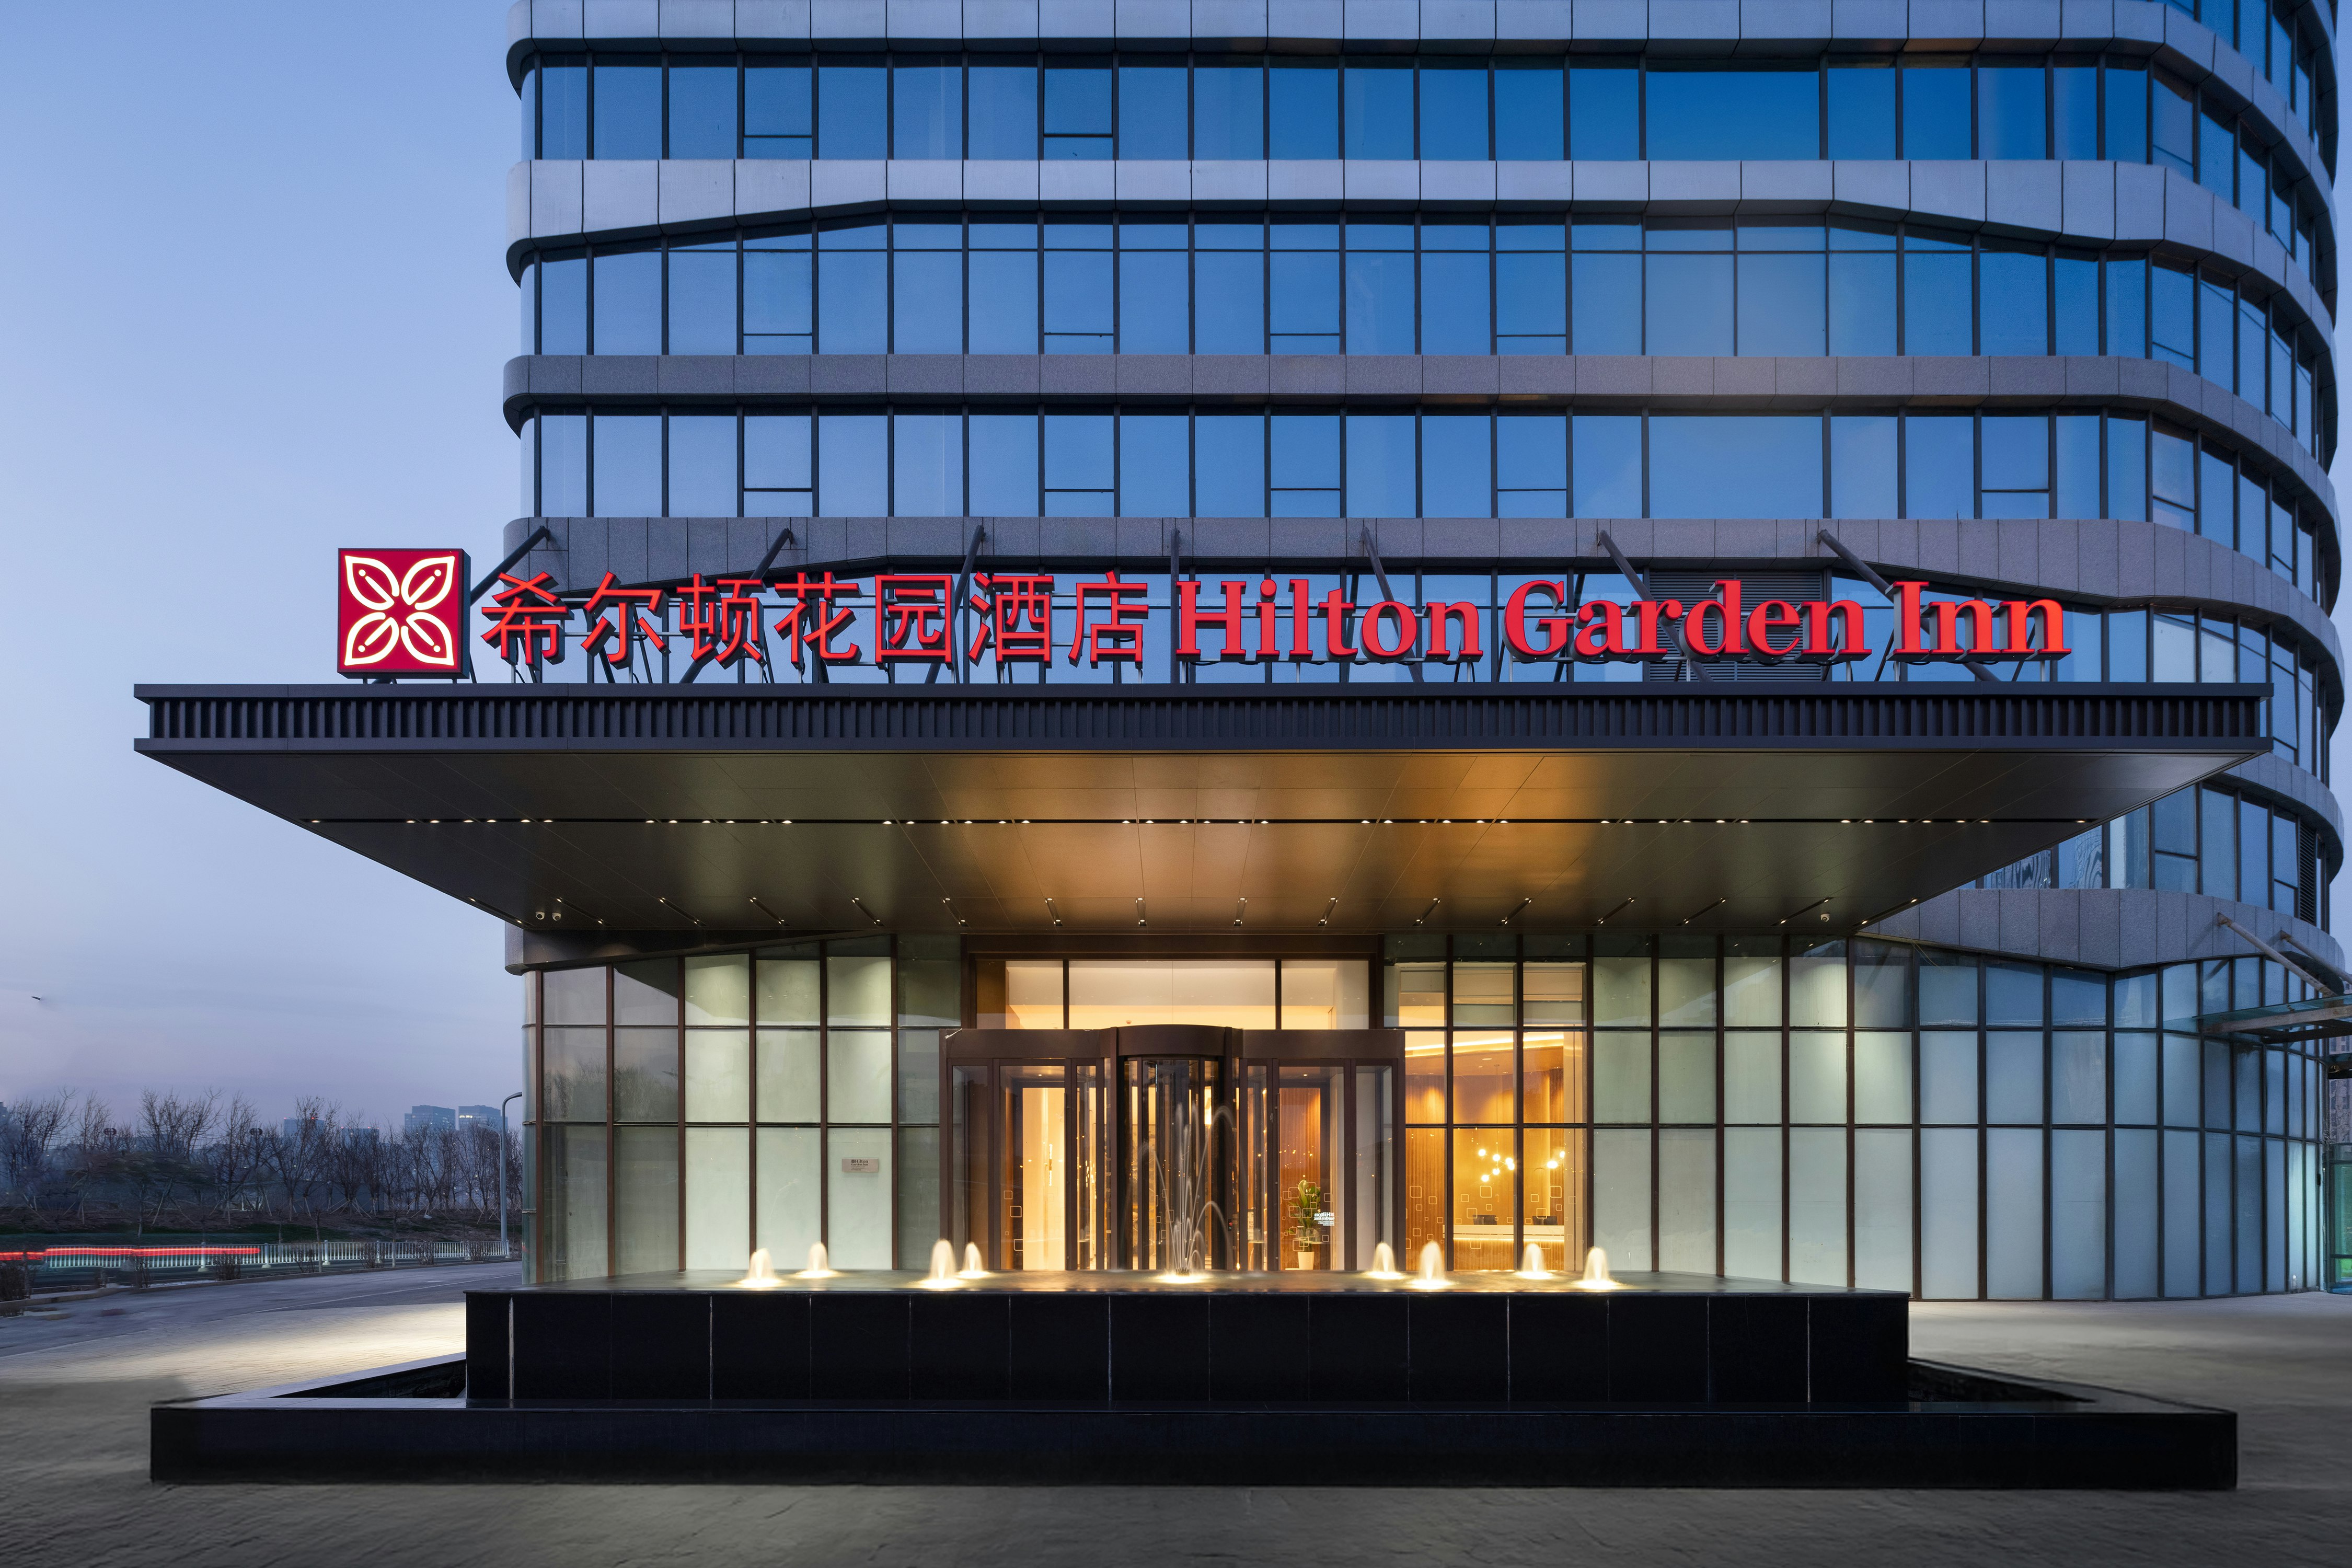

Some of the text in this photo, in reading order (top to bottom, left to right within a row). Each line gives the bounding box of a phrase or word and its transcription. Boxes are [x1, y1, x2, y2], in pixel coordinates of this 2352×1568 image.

[482, 571, 1149, 664] 希尔顿花园酒店
[1174, 579, 2072, 657] Hilton Garden Inn
